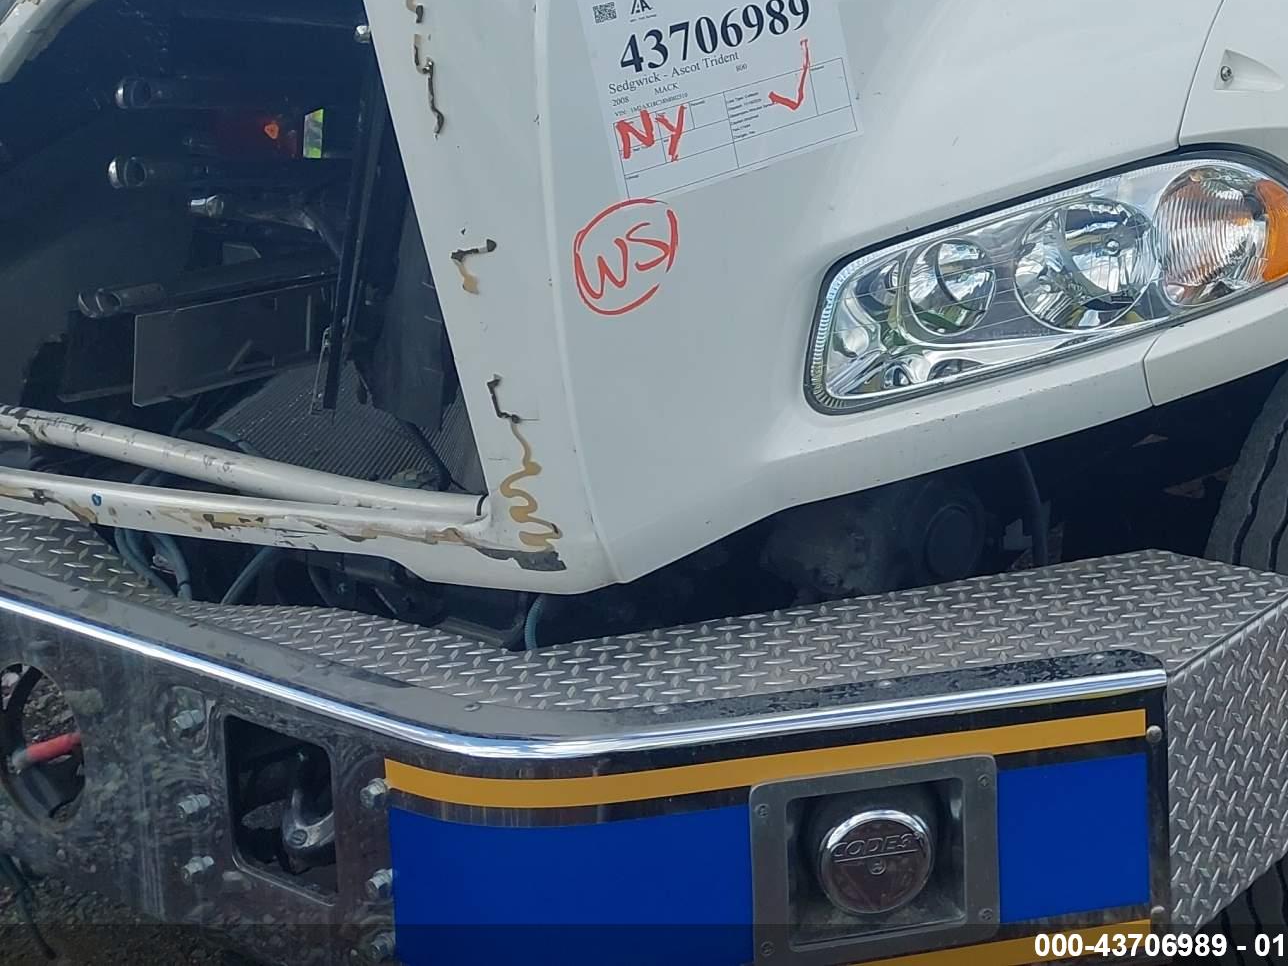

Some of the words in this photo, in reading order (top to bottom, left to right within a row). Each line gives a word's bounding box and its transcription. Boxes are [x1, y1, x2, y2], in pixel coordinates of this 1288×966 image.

[608, 71, 662, 95] Sedgwick
[671, 62, 701, 78] Ascot
[701, 51, 740, 69] Trident
[653, 82, 680, 96] MACK
[615, 104, 687, 163] NY
